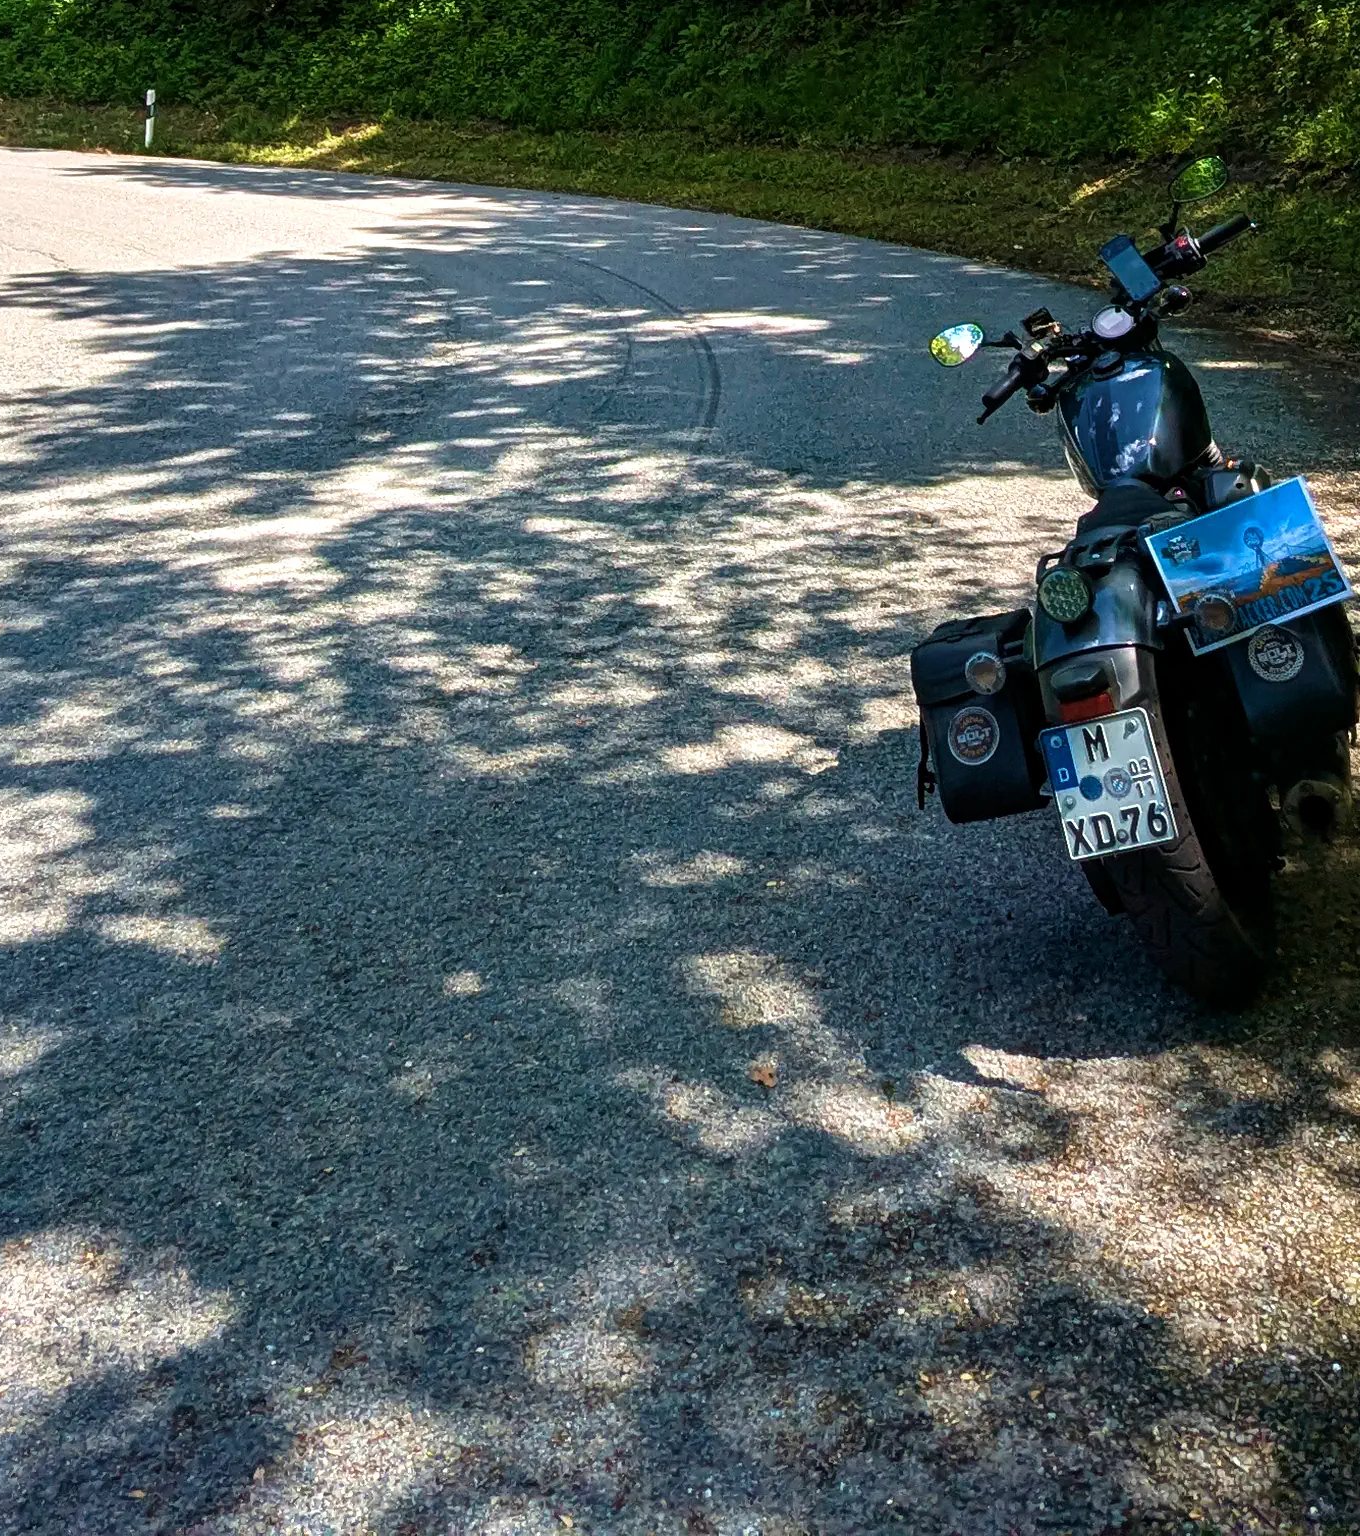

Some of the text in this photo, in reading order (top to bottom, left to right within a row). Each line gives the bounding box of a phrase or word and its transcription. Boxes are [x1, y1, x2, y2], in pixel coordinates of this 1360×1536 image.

[1081, 722, 1112, 763] M
[1057, 767, 1070, 783] D
[1128, 755, 1151, 777] 03
[1134, 781, 1157, 799] 11
